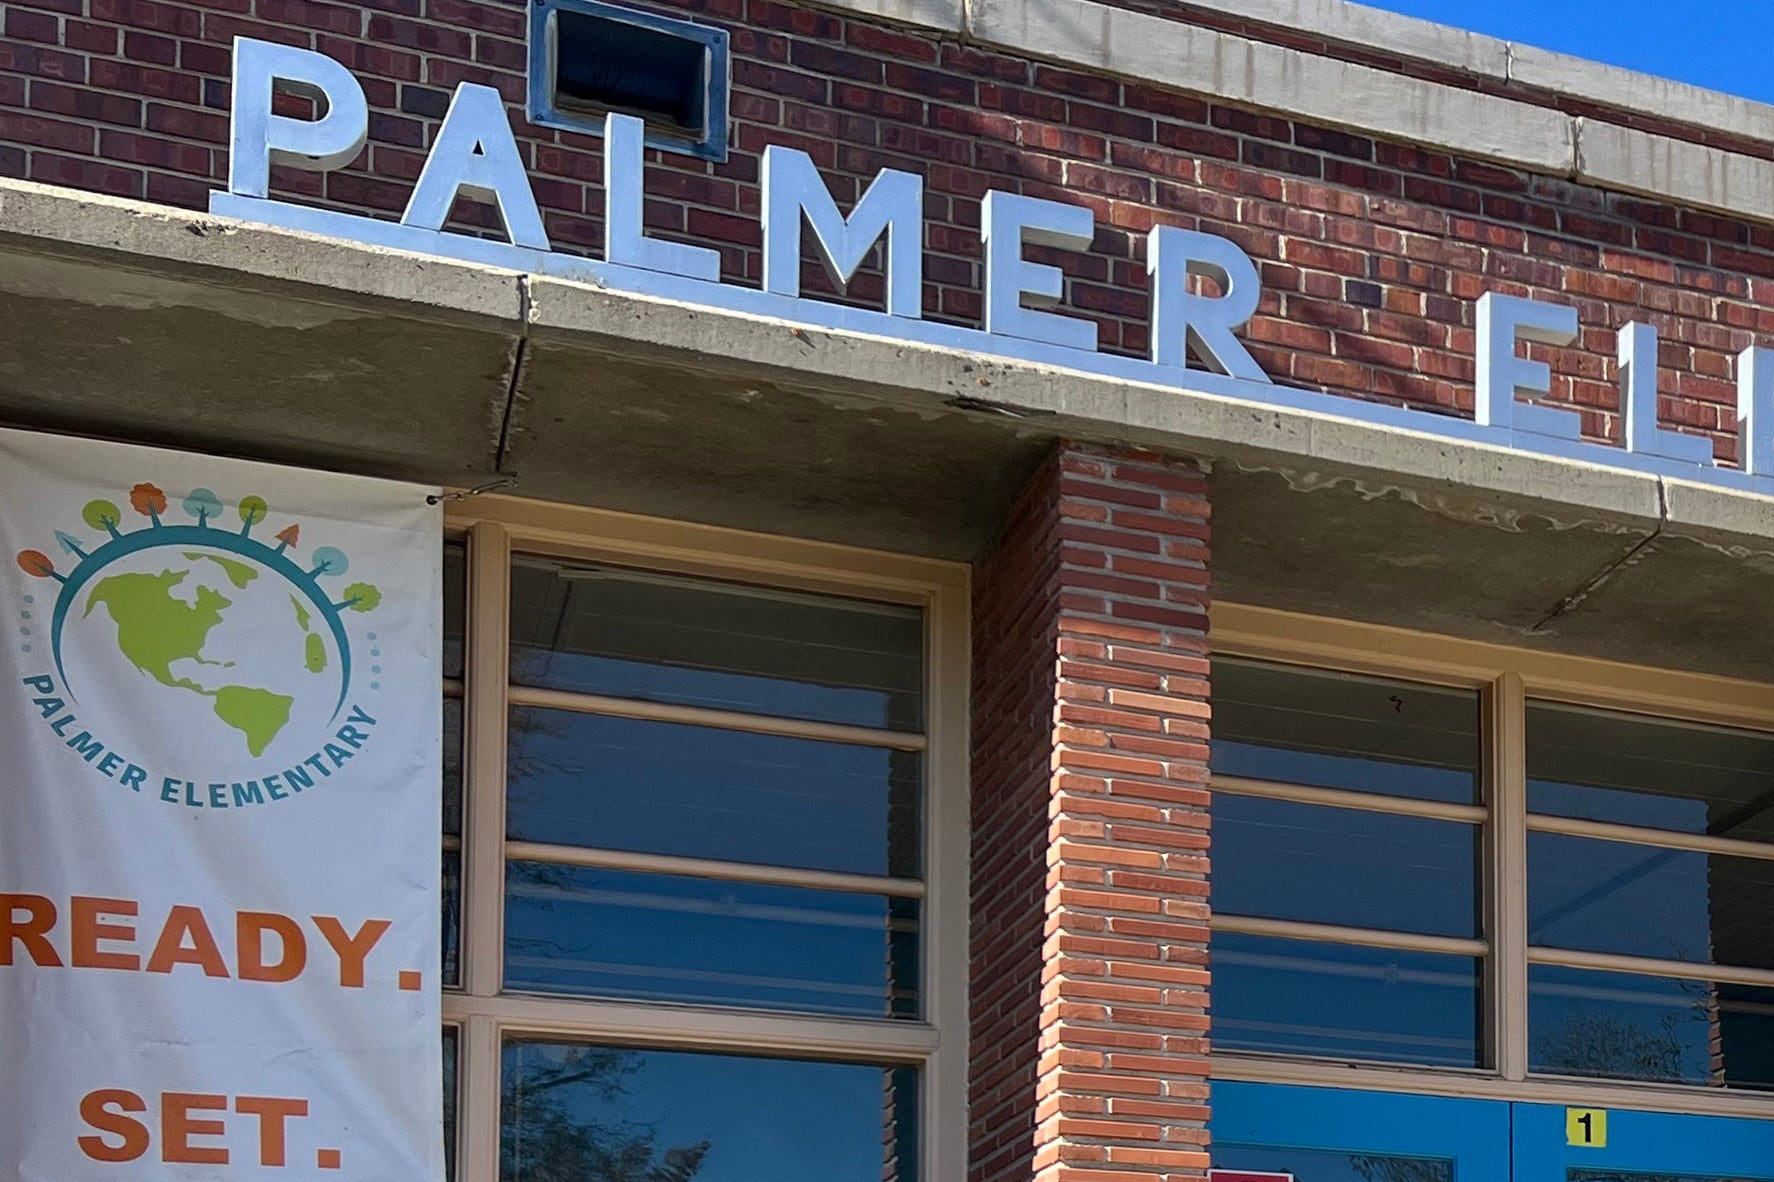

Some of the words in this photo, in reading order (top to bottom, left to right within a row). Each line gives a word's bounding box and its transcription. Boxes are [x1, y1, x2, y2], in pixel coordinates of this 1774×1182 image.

[227, 35, 1274, 386] PALMER
[23, 673, 148, 792] PALMER
[160, 704, 378, 809] ELEMENTARY
[0, 892, 422, 992] READY.
[77, 1088, 342, 1170] SET.
[1578, 1112, 1592, 1143] 1
